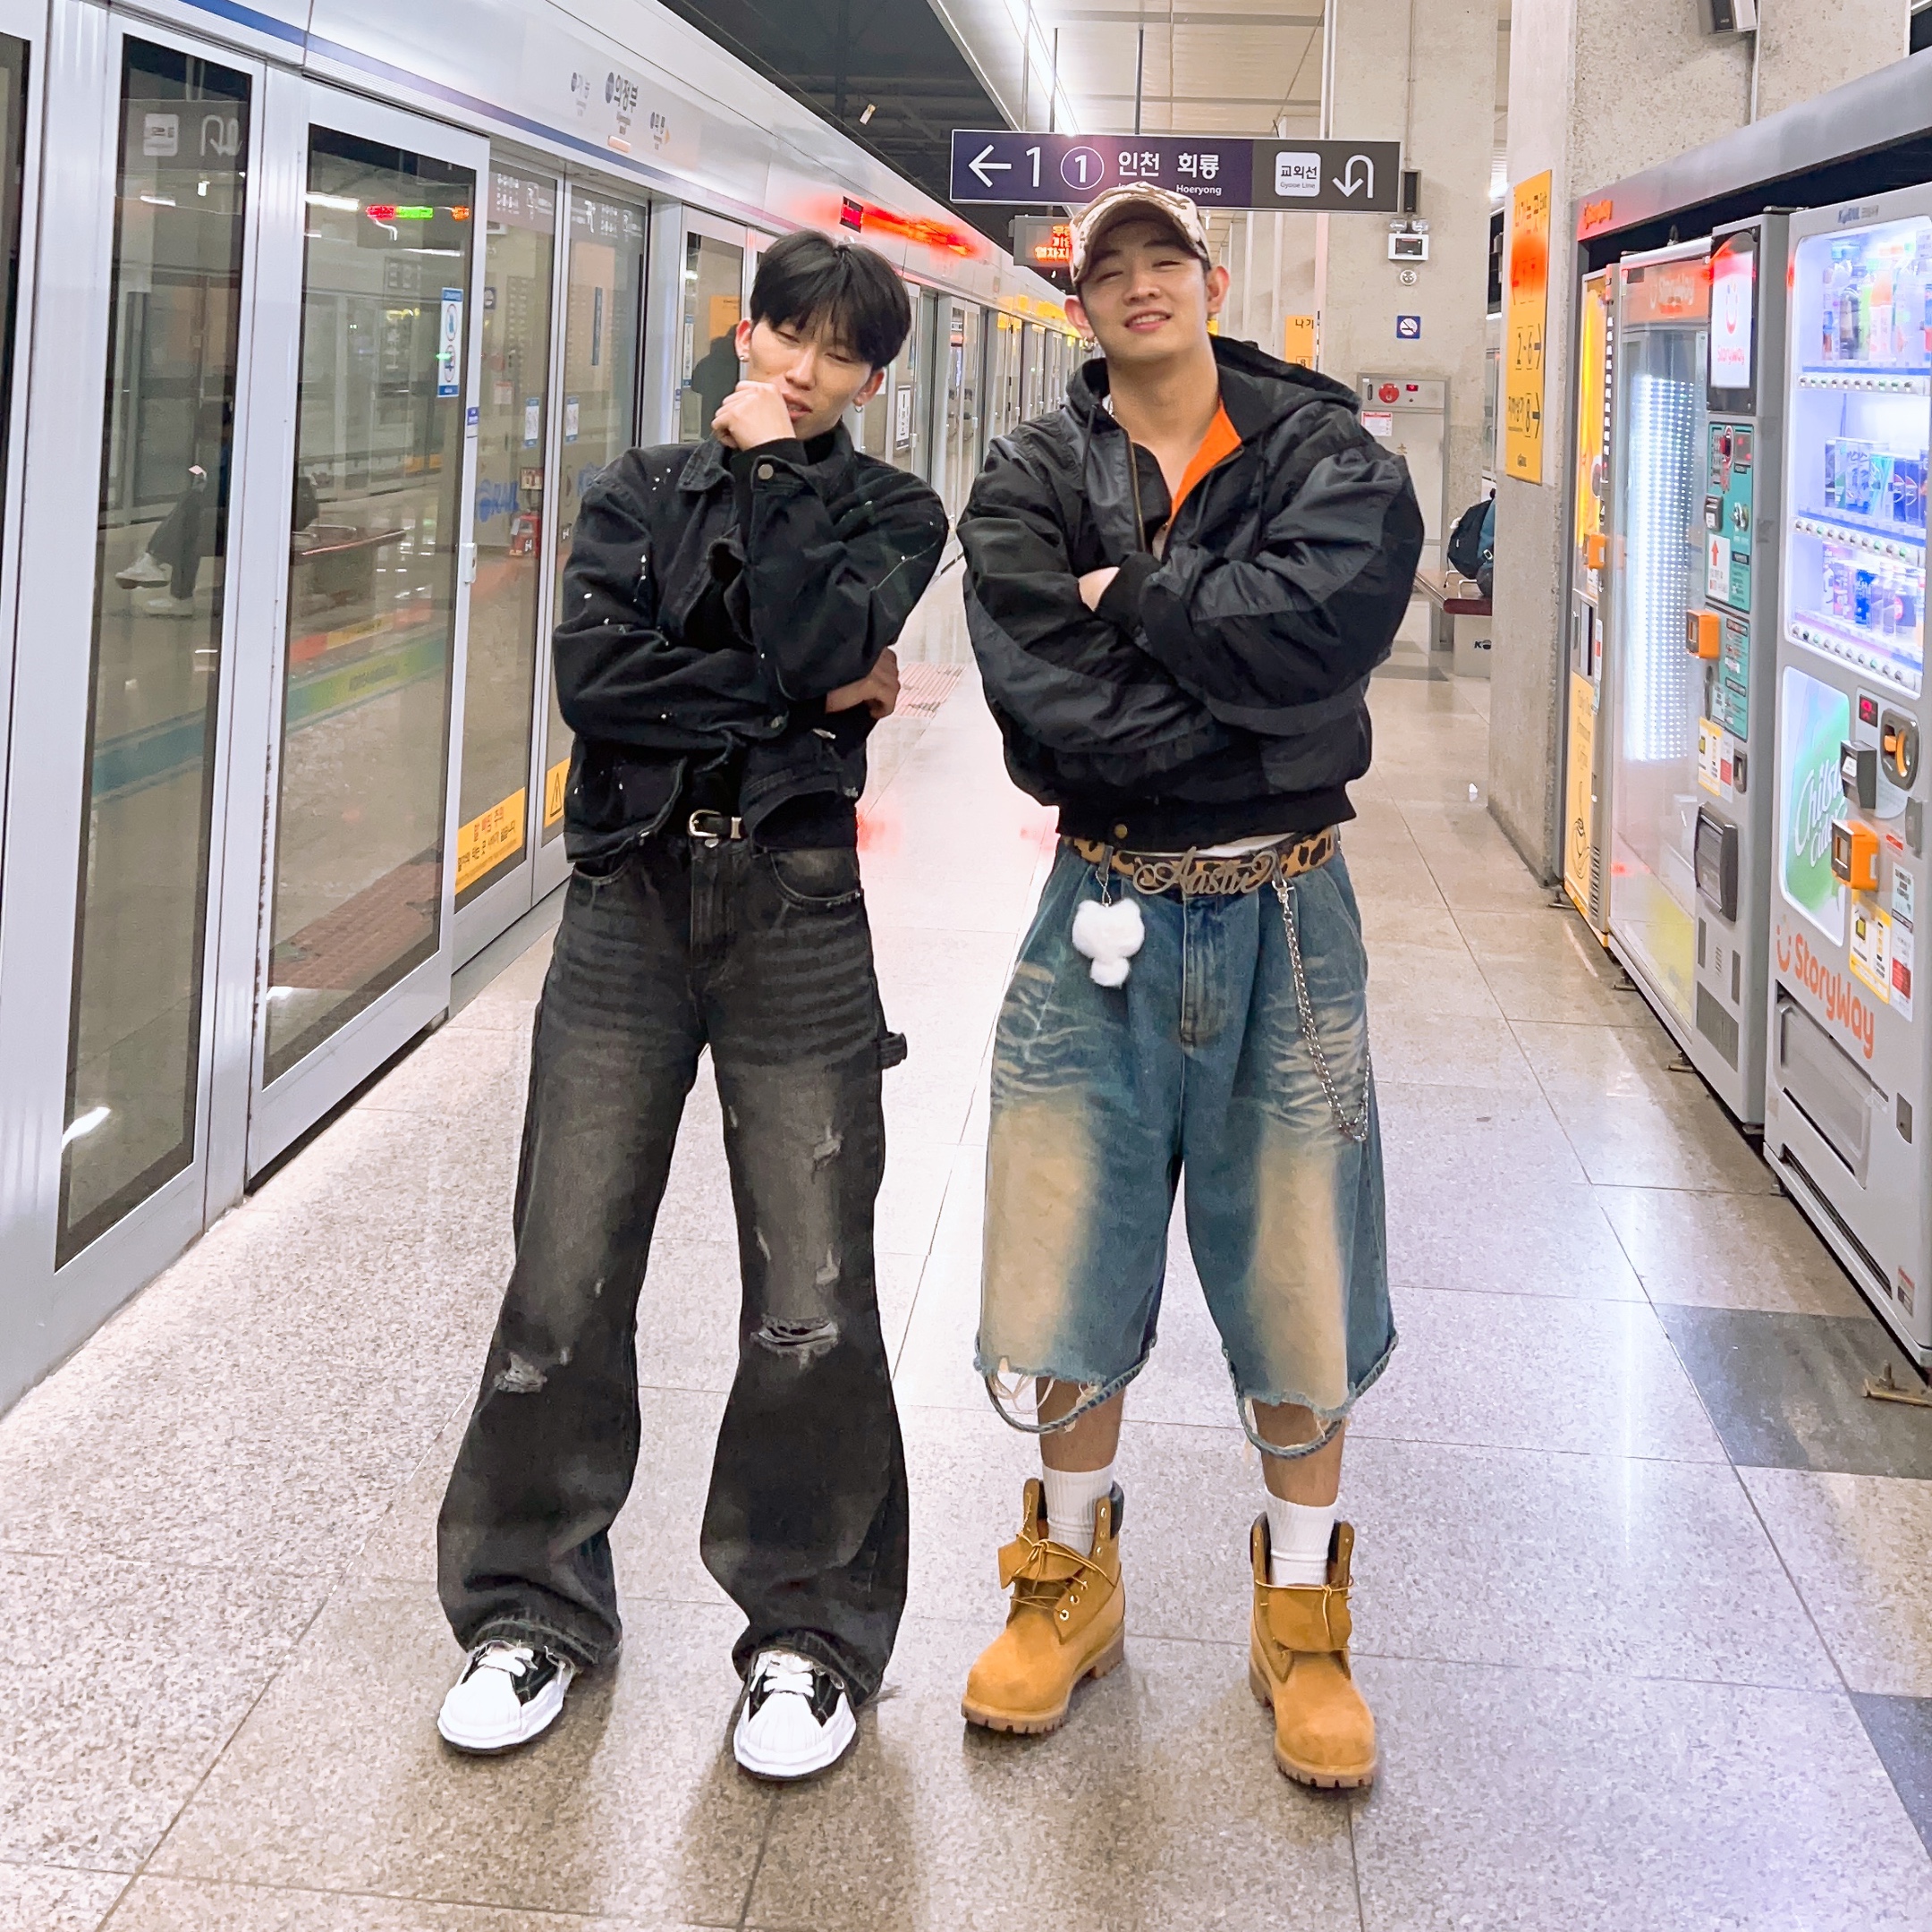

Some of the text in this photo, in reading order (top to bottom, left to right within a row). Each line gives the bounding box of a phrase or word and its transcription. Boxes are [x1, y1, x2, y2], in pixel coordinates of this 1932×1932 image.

[1026, 147, 1041, 188] 1
[1118, 151, 1160, 177] 인천
[1177, 152, 1220, 180] 회룡
[1280, 165, 1318, 180] 교외선
[1175, 184, 1222, 196] Hoeryong
